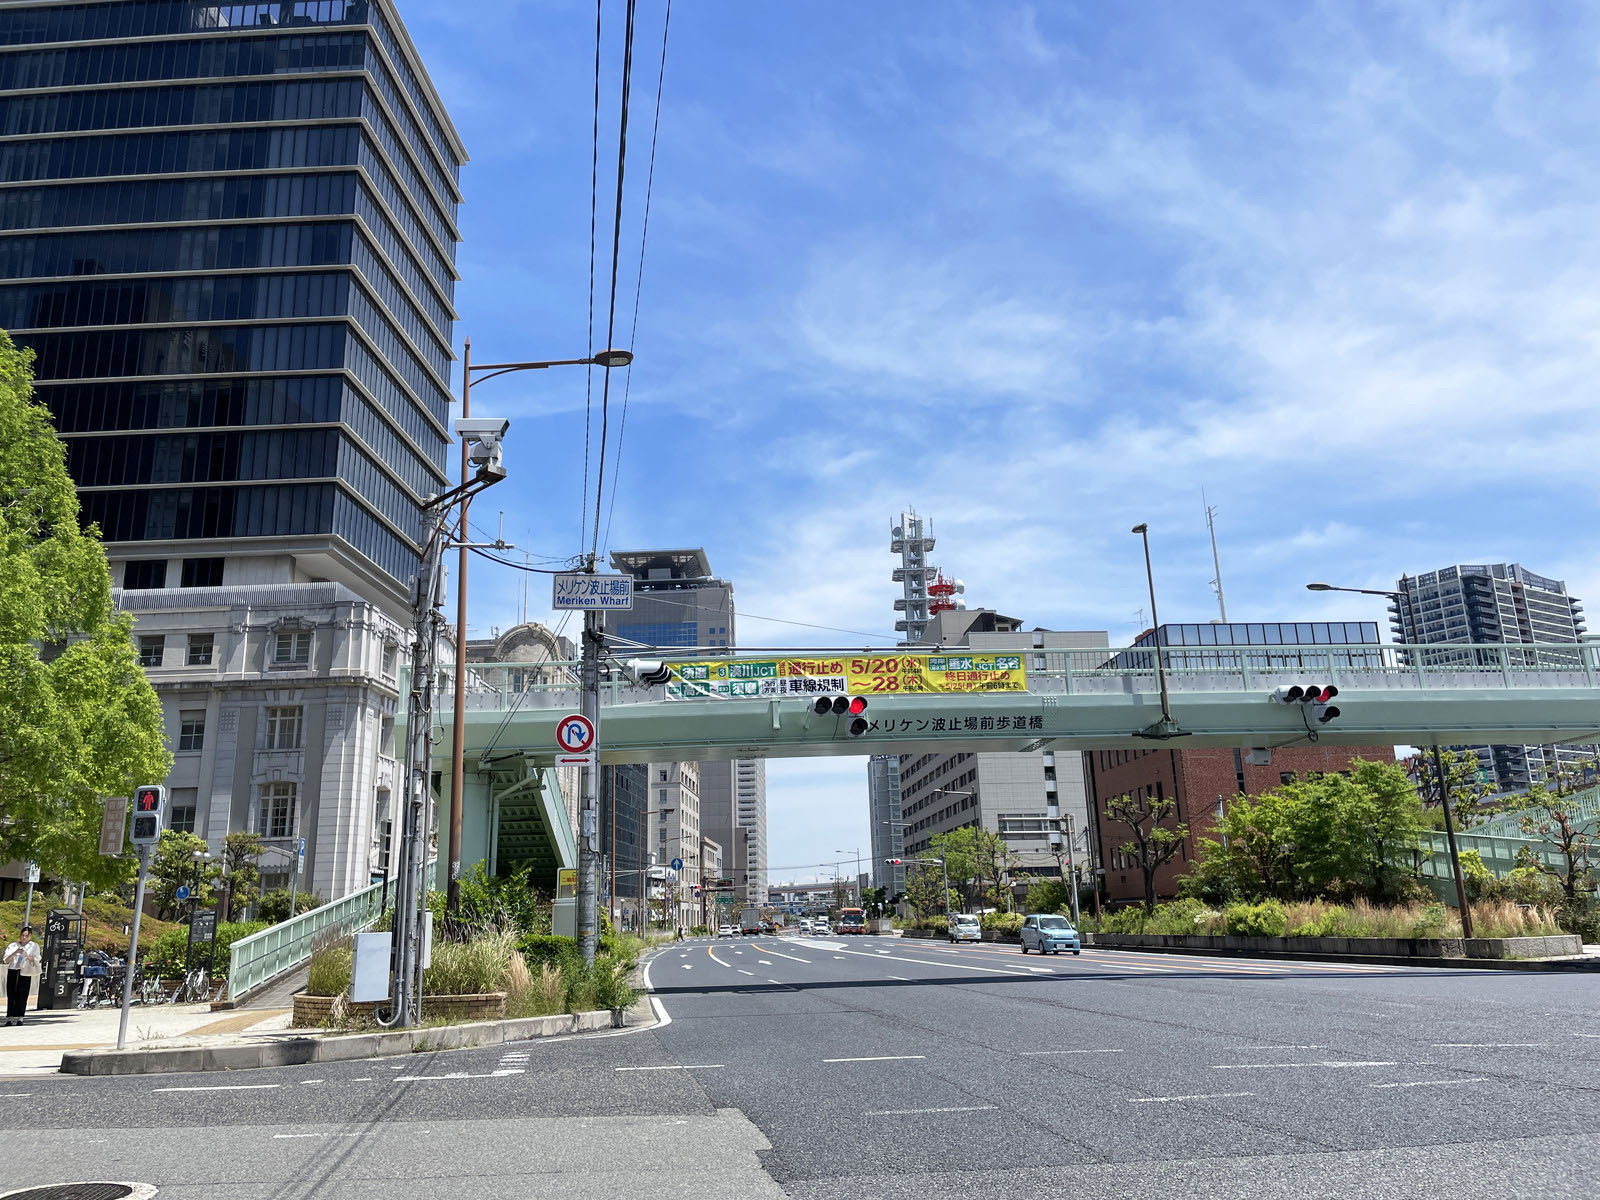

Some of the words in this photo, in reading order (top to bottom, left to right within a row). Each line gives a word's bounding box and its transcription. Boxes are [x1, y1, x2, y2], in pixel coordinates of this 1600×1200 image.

[557, 579, 630, 595] メリケン波止場前
[557, 596, 596, 605] Meriken
[600, 596, 629, 605] Wharf
[719, 668, 726, 676] 3
[730, 664, 775, 677] 湊川JCT
[788, 661, 843, 675] 通行止め
[851, 658, 899, 675] 5/20
[944, 671, 1010, 681] 終日通行止め
[789, 678, 844, 693] 車線規制
[868, 715, 1044, 733] メリケン波止場前歩道橋
[57, 985, 65, 995] 3
